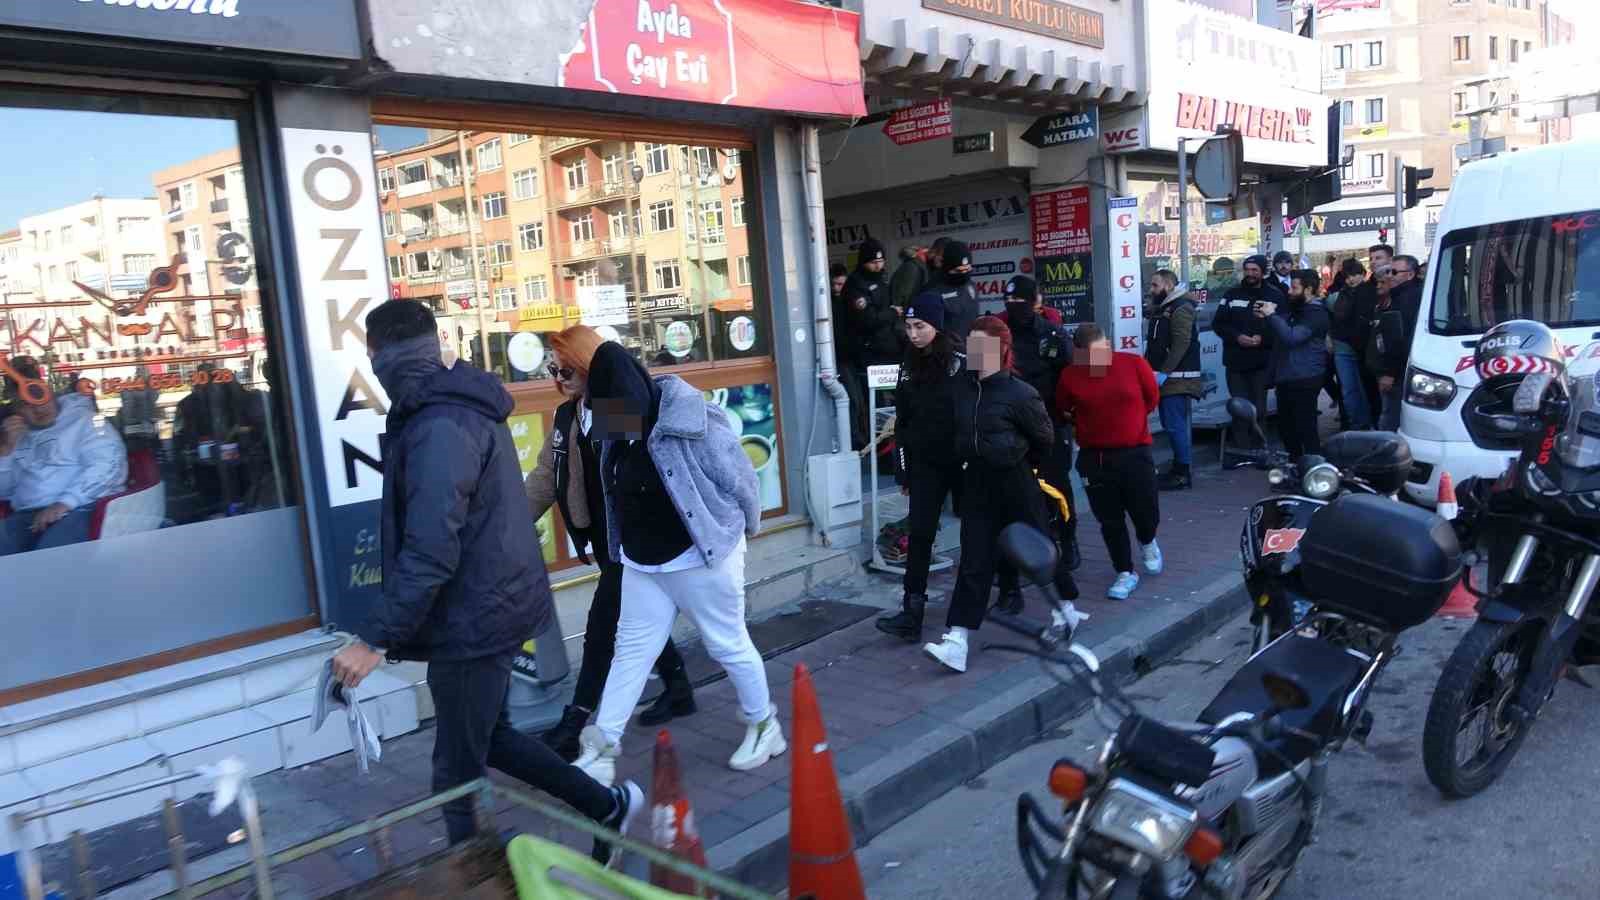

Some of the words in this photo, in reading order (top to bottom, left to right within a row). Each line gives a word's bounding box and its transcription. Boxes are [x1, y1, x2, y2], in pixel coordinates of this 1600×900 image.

[638, 0, 692, 43] Ayda
[626, 44, 668, 88] Çay
[675, 50, 708, 83] Evi
[1043, 128, 1095, 146] MATBAA
[1048, 113, 1090, 131] ALARA
[1105, 128, 1139, 144] WC
[913, 196, 1025, 228] TRUVA
[303, 144, 386, 488] ÖZKAN
